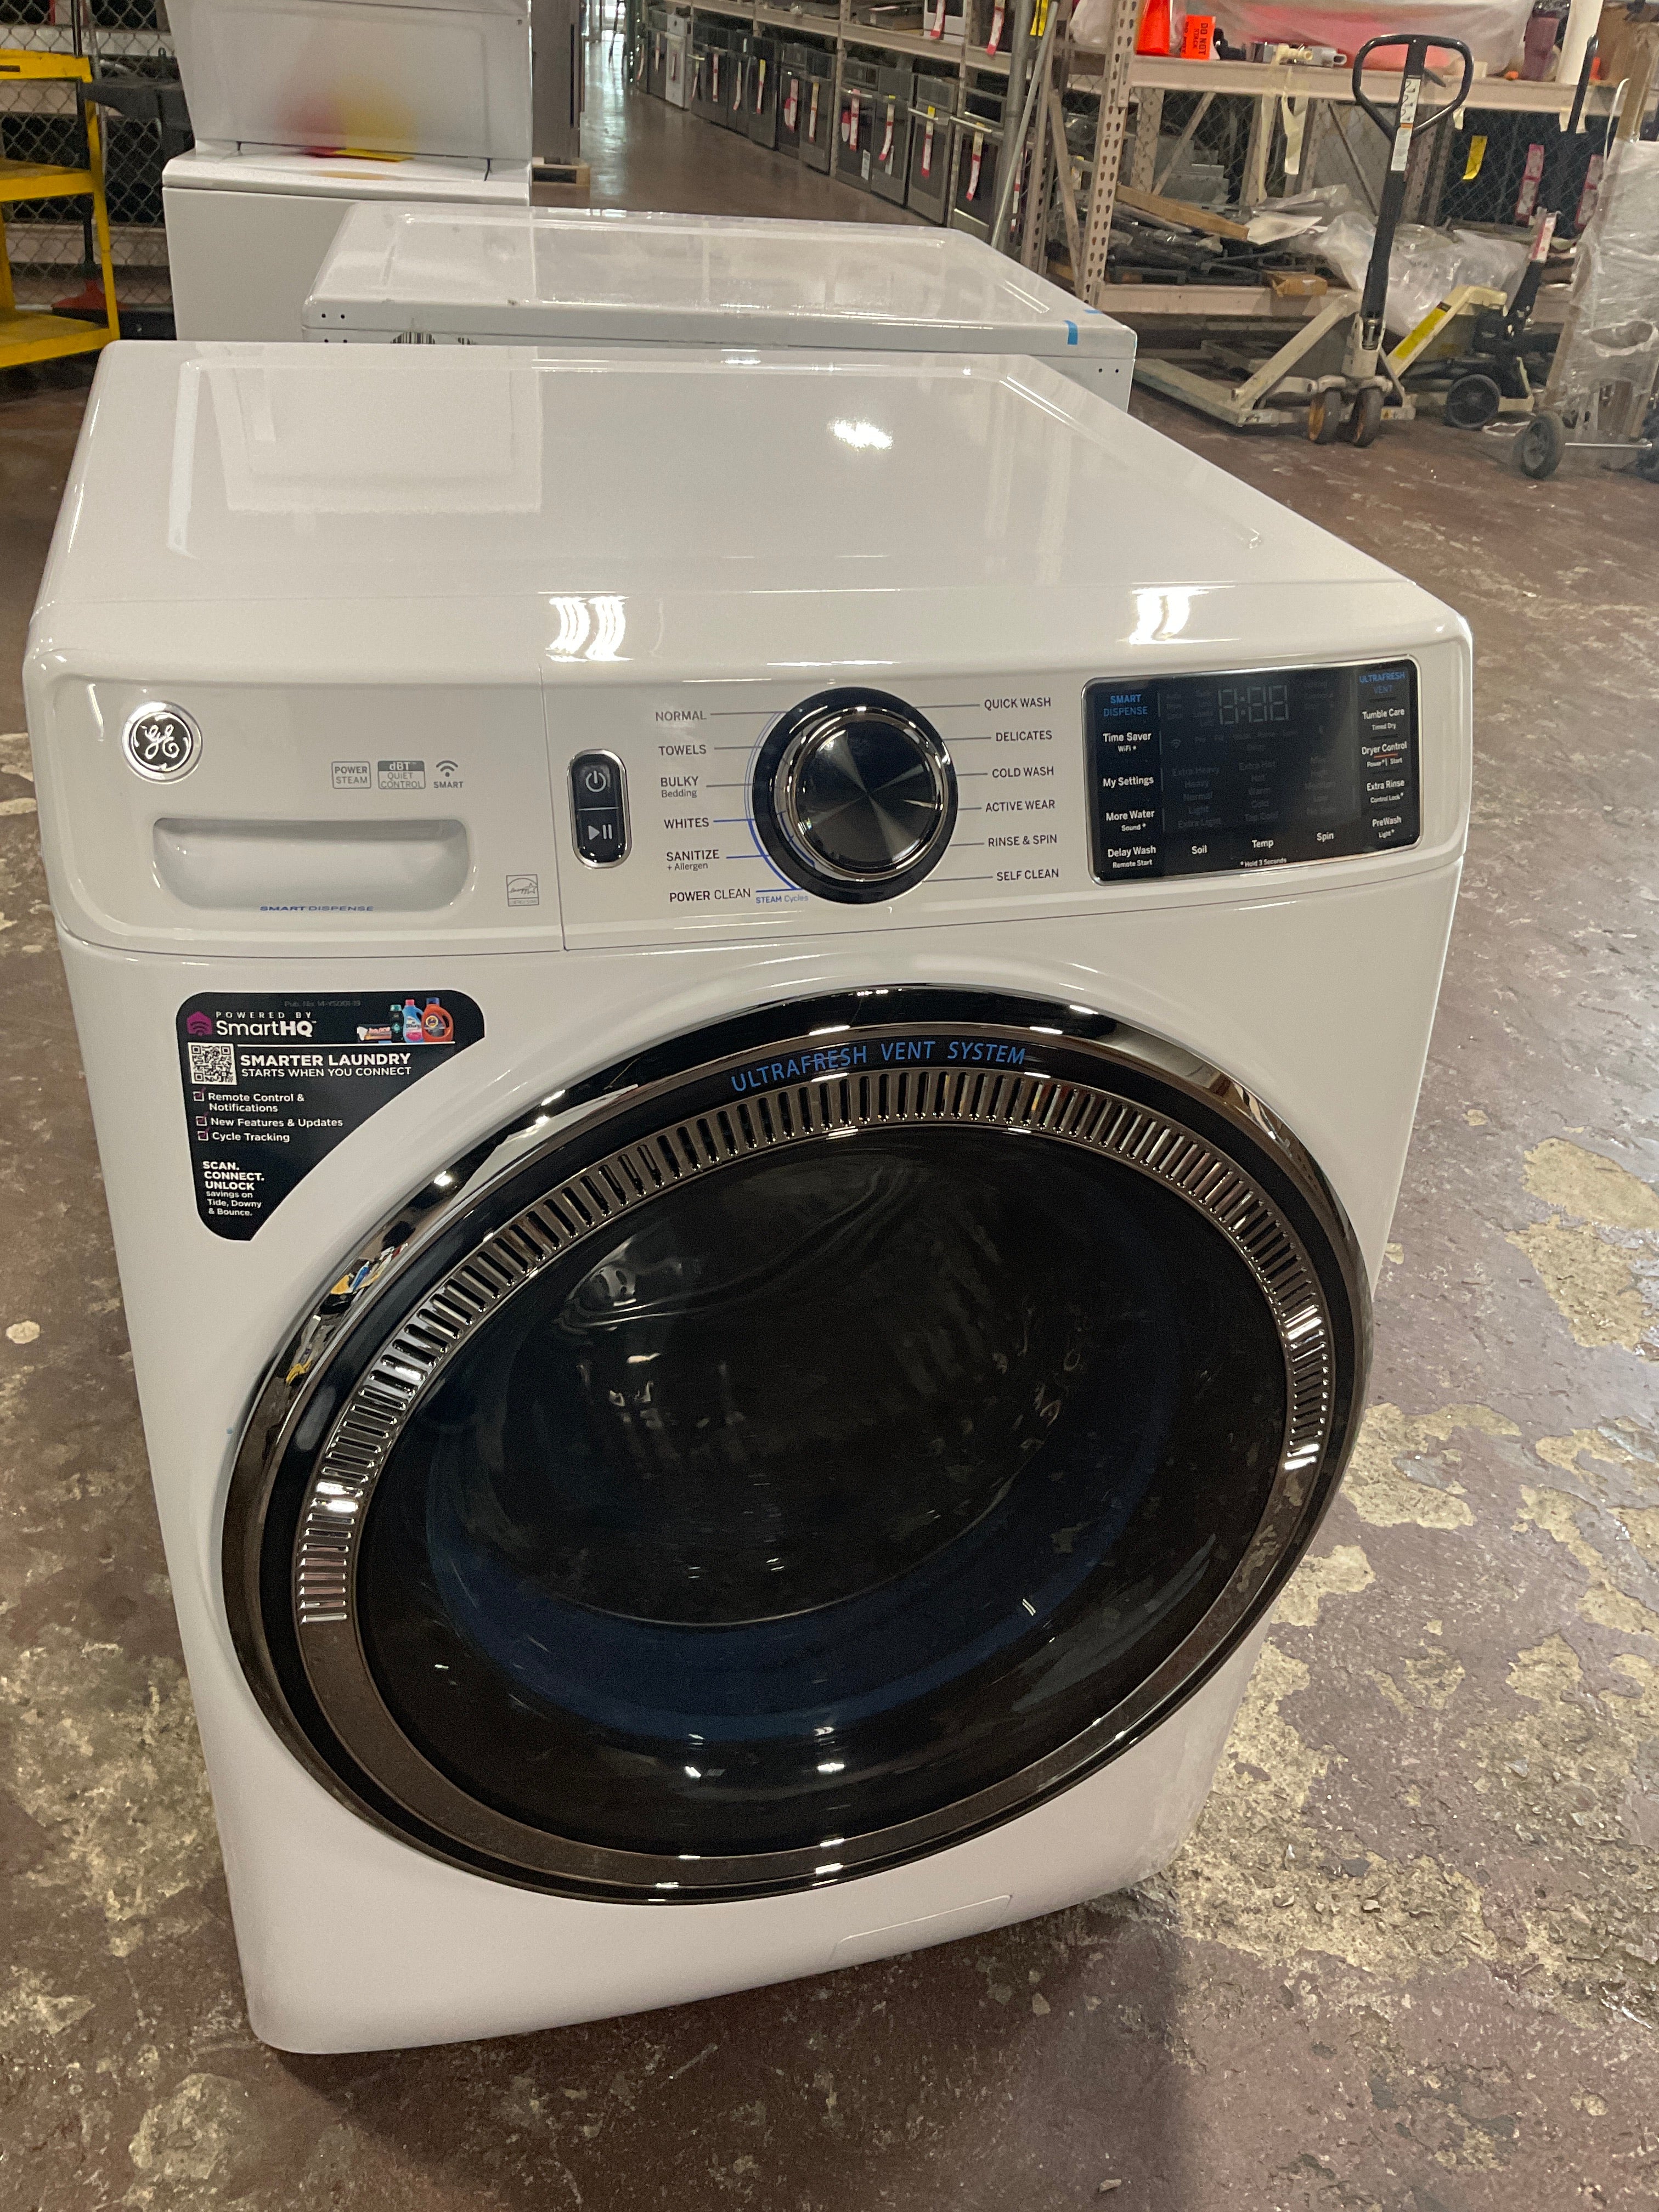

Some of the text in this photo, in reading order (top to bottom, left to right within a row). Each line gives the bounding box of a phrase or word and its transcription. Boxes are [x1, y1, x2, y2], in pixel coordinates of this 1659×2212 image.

[1200, 23, 1208, 35] DO
[1359, 672, 1406, 683] ULTRAFRESH
[1374, 685, 1393, 694] VENT
[984, 697, 1051, 711] QUICK WASH
[1110, 694, 1141, 704] SMART
[655, 711, 707, 721] NORMAL
[1103, 706, 1148, 716] DISPENSE
[1362, 708, 1405, 720] Tumble Care
[996, 730, 1052, 742] DELICATES
[1103, 732, 1152, 742] Time Saver
[658, 745, 707, 755] TOWELS
[1362, 741, 1407, 756] Dryer Control
[387, 772, 413, 780] QUIET
[992, 766, 1054, 778] COLD WASH
[661, 776, 699, 787] BULKY
[1103, 776, 1154, 788] My Settings
[1367, 780, 1405, 791] Extra Rinse
[661, 788, 697, 798] Bedding
[985, 800, 1055, 811] ACTIVE WEAR
[1106, 810, 1155, 821] More Water
[664, 818, 709, 828] WHITES
[1372, 816, 1402, 827] PreWash
[1121, 823, 1141, 832] Sound
[988, 834, 1057, 847] RINSE & SPIN
[1316, 832, 1334, 842] Spin
[1191, 844, 1207, 855] Soil
[1251, 839, 1274, 849] Temp
[667, 850, 720, 861] SANITIZE
[1108, 845, 1156, 857] Delay Wash
[674, 862, 708, 871] Allergen
[1263, 857, 1287, 866] Seconds
[997, 868, 1059, 881] SELF CLEAN
[670, 888, 751, 902] POWER CLEAN
[784, 894, 809, 902] Cycles
[216, 1020, 313, 1037] SmartHQ
[240, 1053, 411, 1067] SMARTER LAUNDRY
[241, 1066, 411, 1077] STARTS WHEN YOU CONNECT
[731, 1041, 1026, 1092] ULTRAFRESH VENT SYSTEM
[208, 1092, 305, 1102] Remote Control &
[209, 1103, 278, 1113] Notifications
[211, 1118, 343, 1128] New Features & Updates
[212, 1132, 290, 1143] Cycle Tracking
[202, 1161, 240, 1170] SCAN.
[204, 1171, 264, 1181] CONNECT.
[205, 1181, 255, 1190] UNLOCK
[206, 1190, 239, 1199] savings
[207, 1198, 262, 1209] Tide, Downy
[217, 1208, 253, 1216] Bounce.
